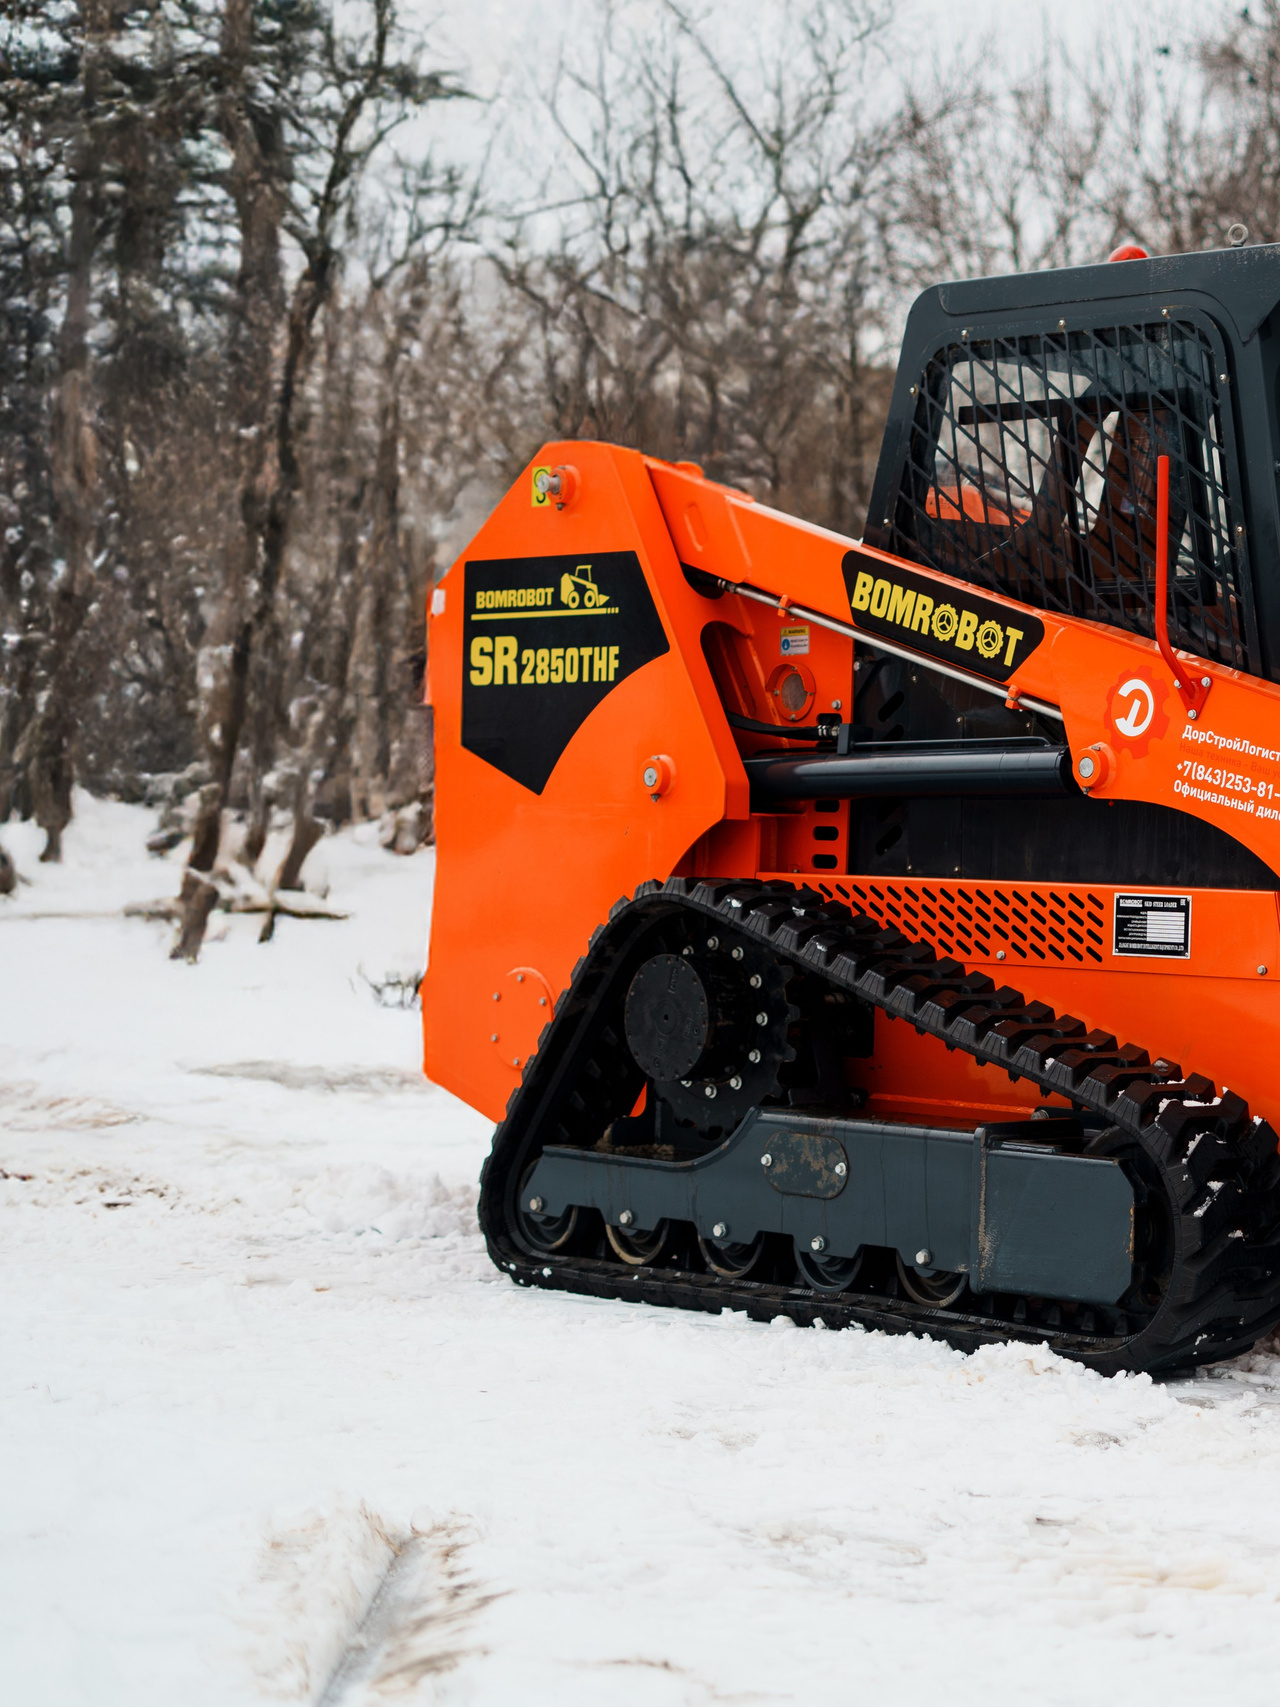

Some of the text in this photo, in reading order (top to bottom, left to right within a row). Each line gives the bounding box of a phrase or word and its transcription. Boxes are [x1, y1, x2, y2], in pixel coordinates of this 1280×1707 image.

[475, 587, 555, 609] BOMROBOT
[851, 571, 1024, 668] BOMROBOT
[469, 635, 620, 686] SR 2850THF
[1179, 742, 1204, 757] Наша
[1206, 751, 1242, 768] техника
[1250, 761, 1271, 776] Ваш
[1173, 780, 1254, 814] Официальный
